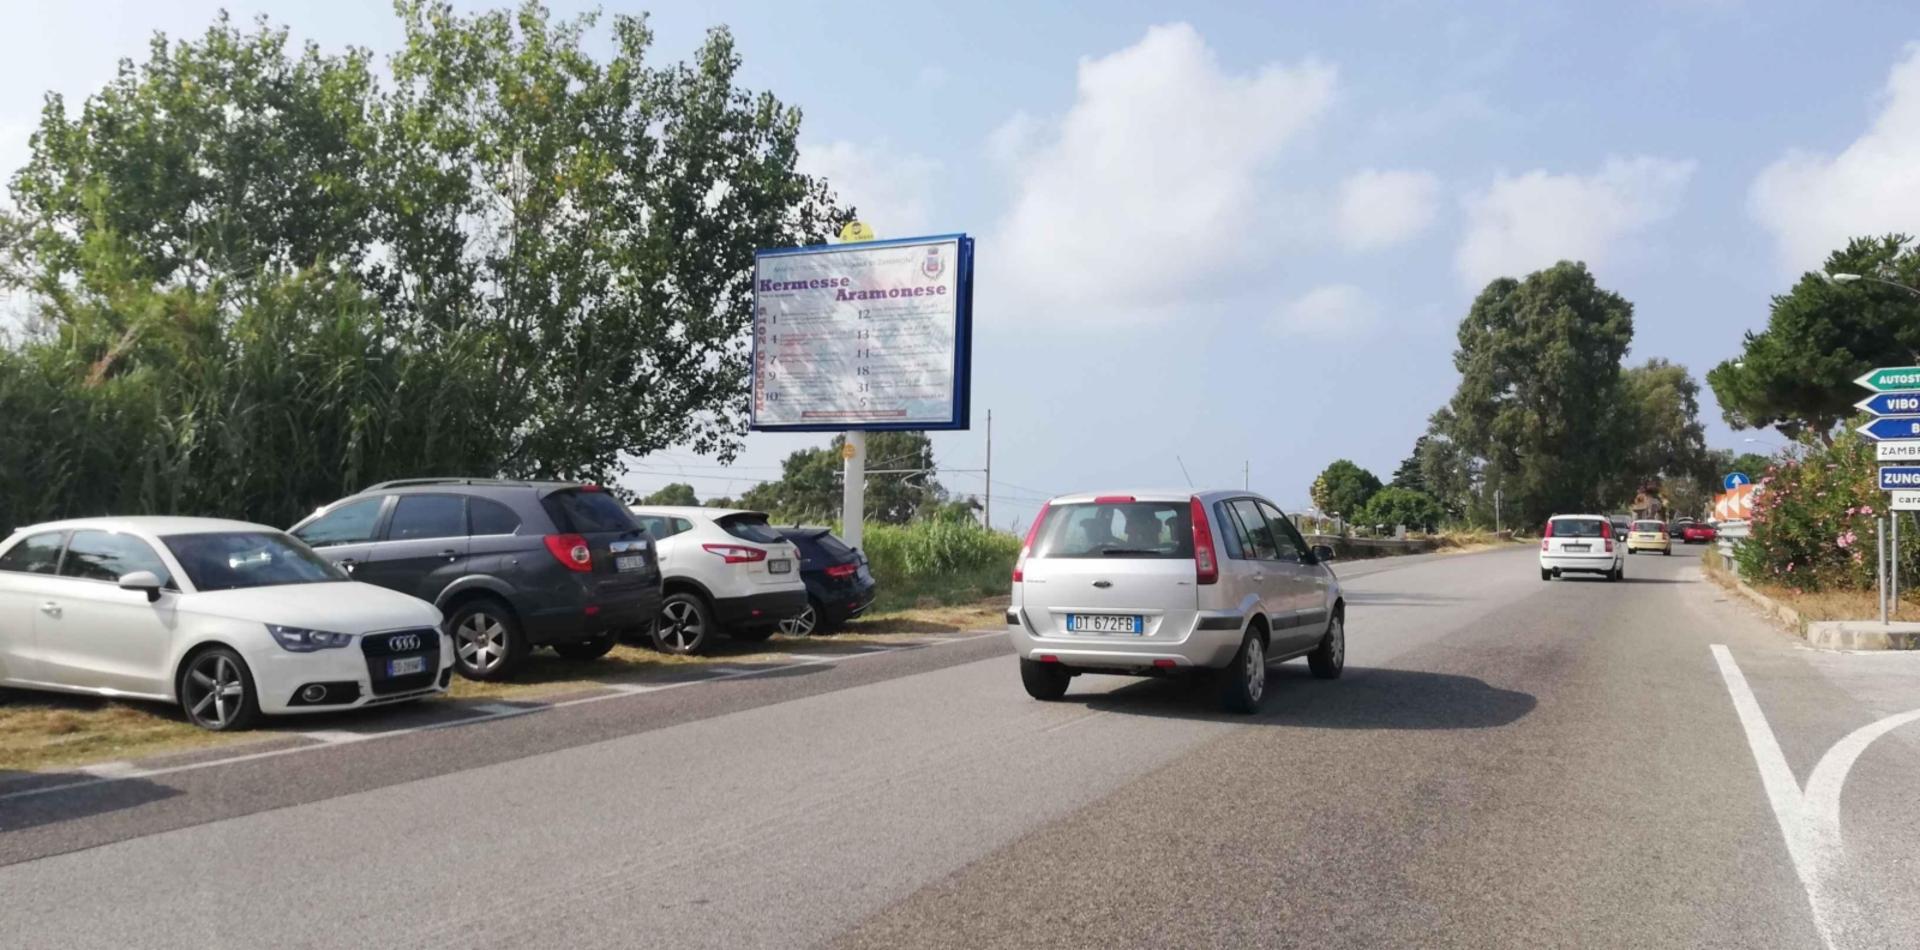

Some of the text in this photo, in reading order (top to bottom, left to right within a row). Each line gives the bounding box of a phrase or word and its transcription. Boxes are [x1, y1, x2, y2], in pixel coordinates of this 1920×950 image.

[759, 276, 850, 293] Kermesse
[835, 284, 947, 302] Aramonese
[857, 308, 871, 319] 12
[857, 329, 870, 340] 13
[756, 306, 767, 411] AGOSTO 2019
[769, 355, 777, 365] 7
[768, 371, 776, 381] 9
[857, 366, 870, 376] 18
[857, 383, 869, 393] 31
[766, 391, 779, 401] 10
[859, 396, 866, 408] 5
[1886, 398, 1919, 410] VIBO
[1075, 616, 1133, 631] DT 672FB
